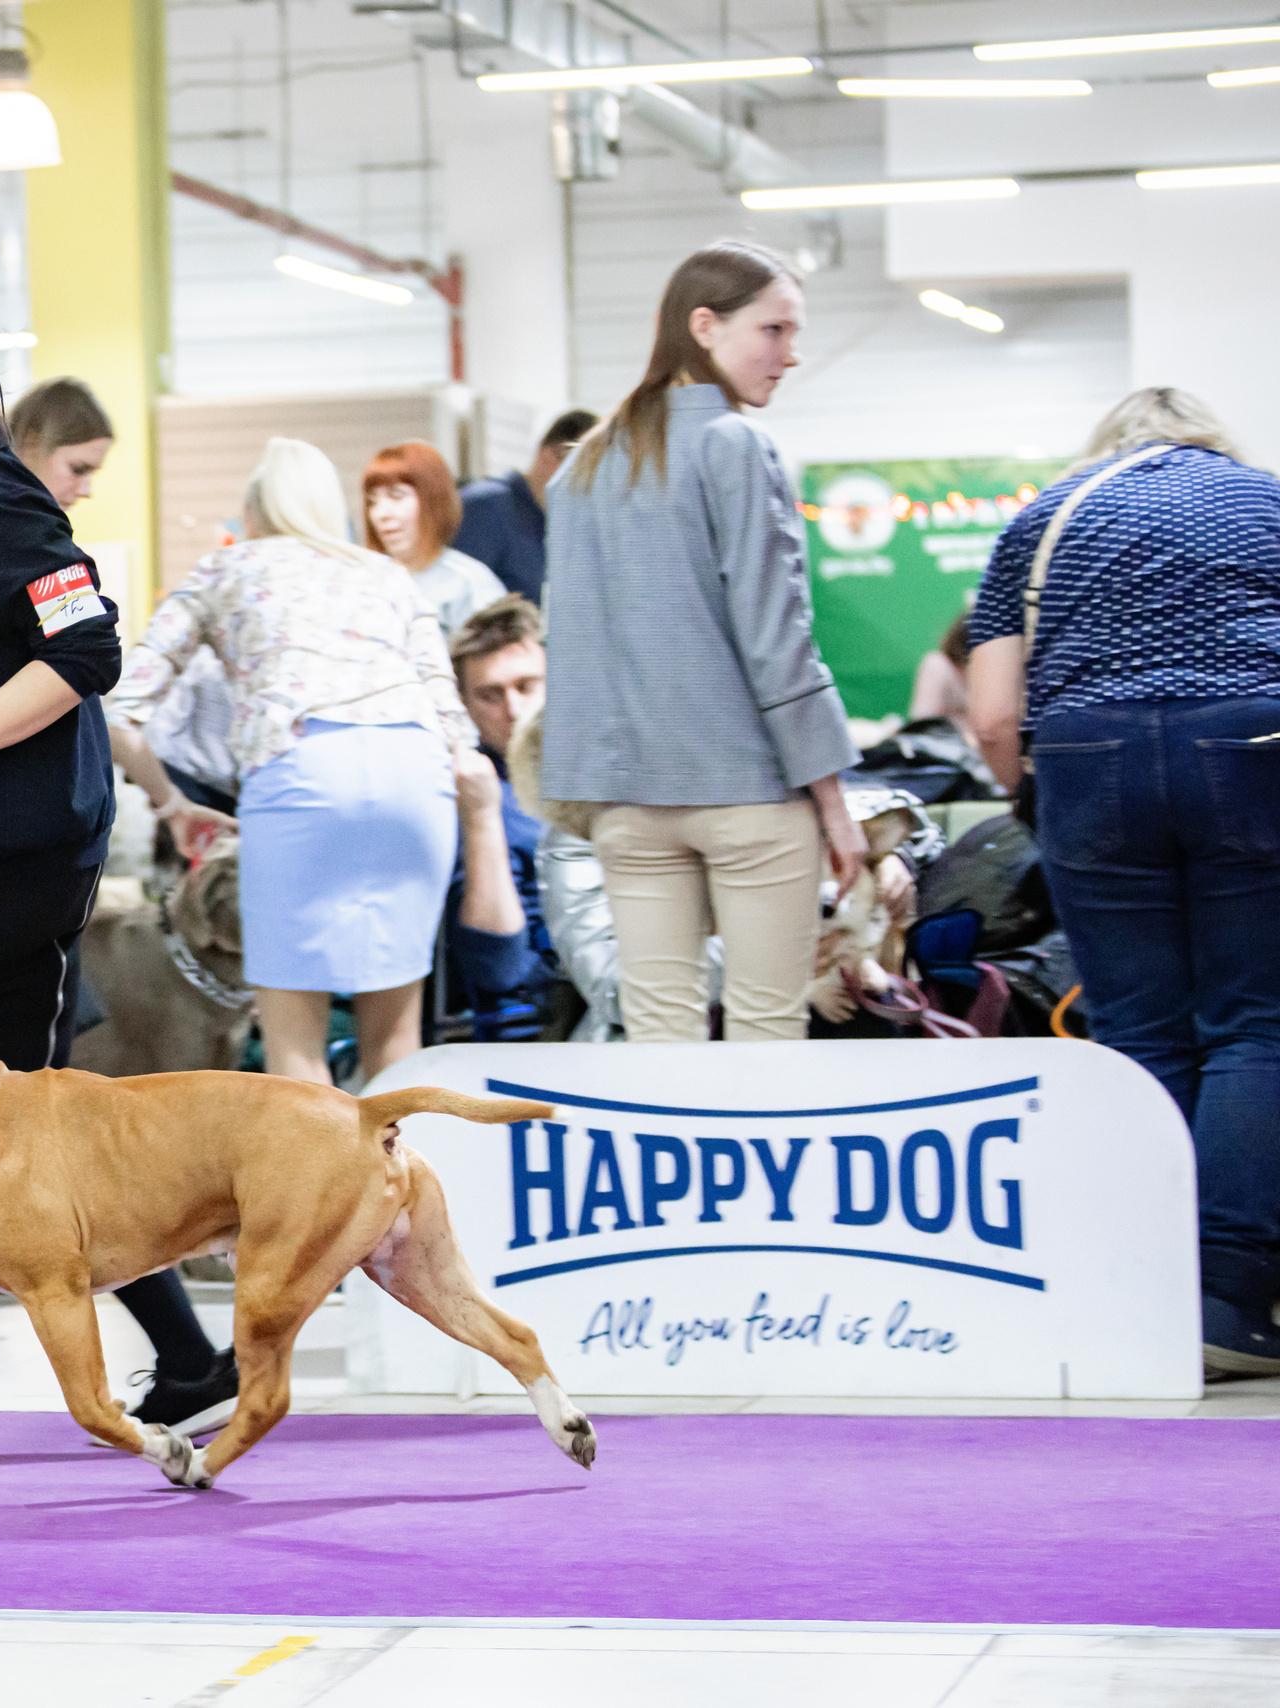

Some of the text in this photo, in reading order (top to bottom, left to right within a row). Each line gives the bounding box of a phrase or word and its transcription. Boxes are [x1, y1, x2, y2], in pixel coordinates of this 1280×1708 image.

[56, 564, 87, 585] Blitz
[507, 1117, 1025, 1251] HAPPY DOG
[578, 1292, 959, 1366] All you feed is love
